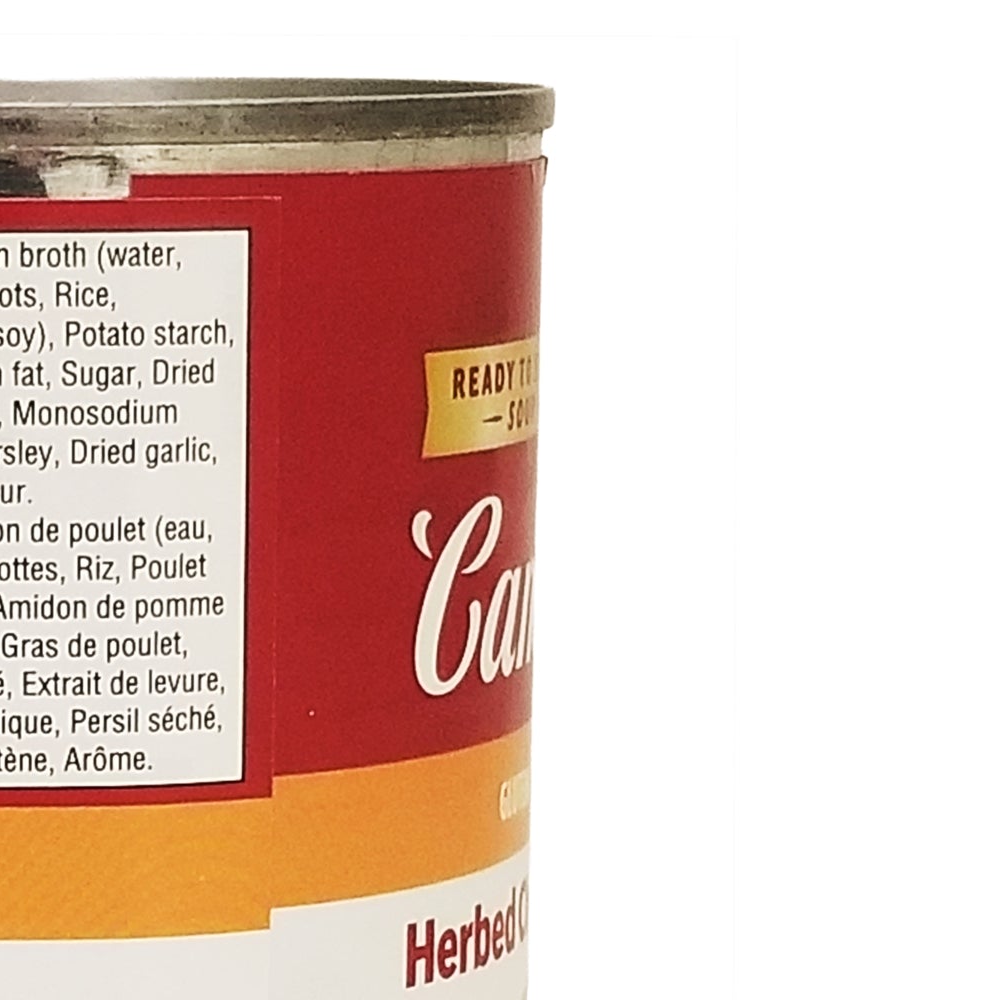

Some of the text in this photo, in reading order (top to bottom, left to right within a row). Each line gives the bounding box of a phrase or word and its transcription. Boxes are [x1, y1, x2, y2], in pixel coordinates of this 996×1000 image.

[20, 241, 86, 268] broth
[97, 240, 181, 274] (water,
[55, 281, 116, 311] Rice,
[65, 321, 145, 347] Potato
[154, 318, 234, 347] starch,
[12, 360, 51, 390] fat,
[61, 360, 142, 392] Sugar,
[153, 357, 215, 385] Dried
[452, 360, 515, 400] READY
[13, 399, 177, 426] Monosodium
[71, 438, 136, 465] Dried
[145, 436, 217, 469] garlic,
[30, 516, 59, 543] de
[69, 516, 146, 549] poulet
[155, 515, 212, 547] (eau,
[77, 555, 120, 584] Riz,
[131, 553, 206, 580] Poulet
[96, 593, 125, 619] de
[135, 596, 224, 624] pomme
[1, 632, 59, 659] Gras
[68, 632, 97, 658] de
[106, 631, 187, 664] poulet,
[23, 670, 102, 697] Extrait
[110, 670, 138, 696] de
[148, 669, 225, 694] levure,
[71, 707, 139, 734] Persil
[148, 703, 222, 733] séché,
[64, 746, 152, 772] Arôme.
[406, 887, 516, 988] Herbed
